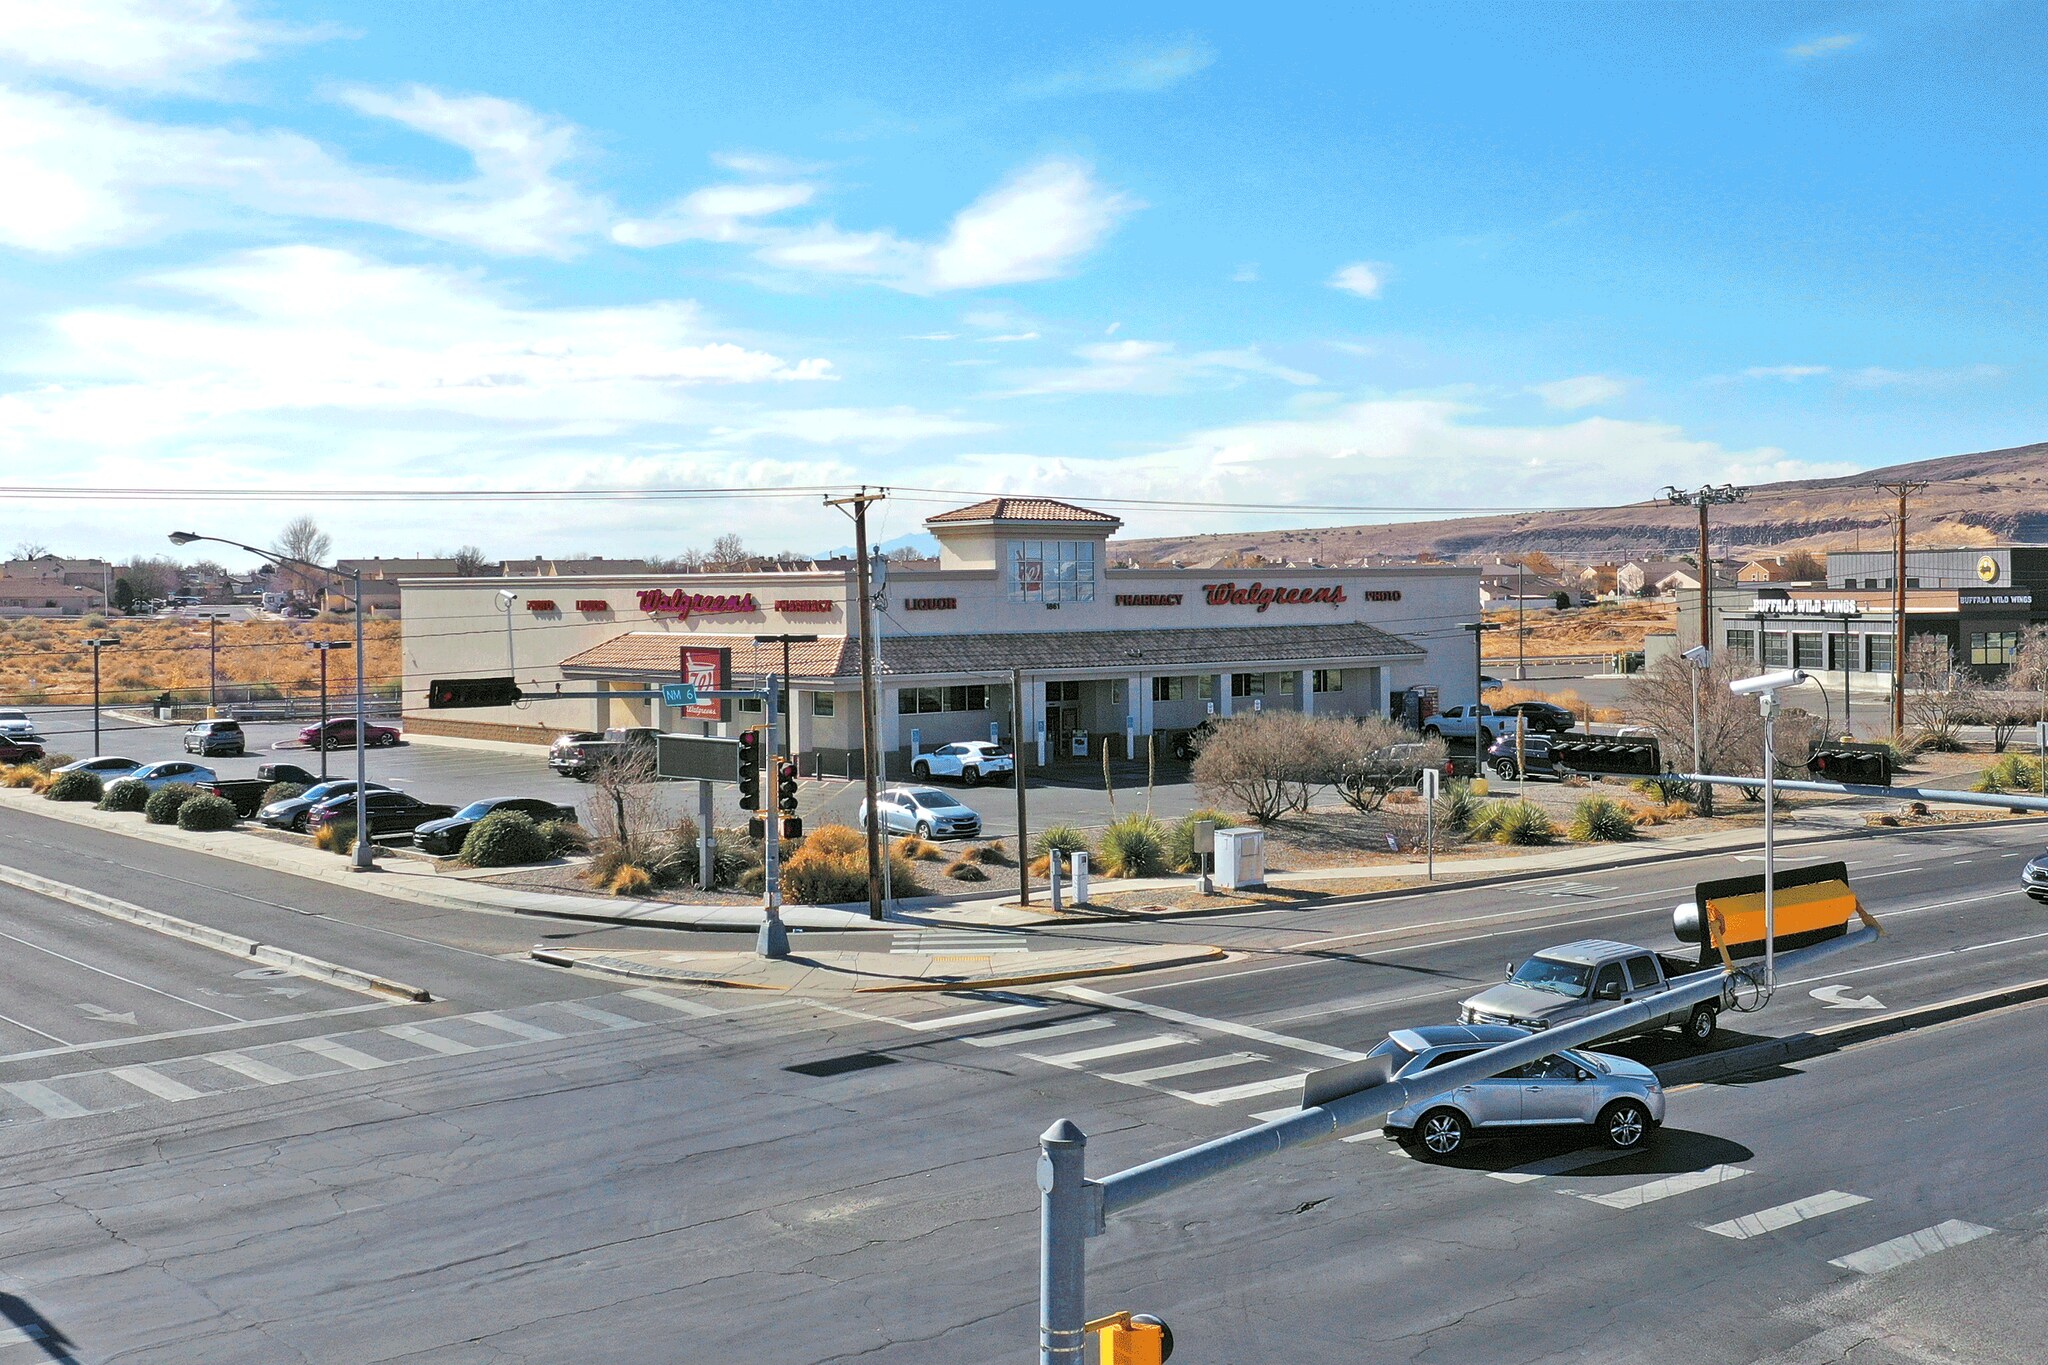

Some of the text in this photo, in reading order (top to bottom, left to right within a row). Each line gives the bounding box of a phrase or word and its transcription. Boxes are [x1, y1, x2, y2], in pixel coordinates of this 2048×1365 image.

[1114, 594, 1184, 606] PHARMACY
[1202, 582, 1348, 612] Walgreens
[1364, 590, 1402, 602] PHOTO
[1960, 595, 2033, 604] BUFFALO WILD WINGS
[636, 588, 757, 621] Walgreens
[774, 600, 833, 612] PHARMACY
[904, 598, 958, 611] LIQUOR
[1753, 599, 1857, 614] BUFFALO WILD WINGS
[666, 689, 694, 701] NM 6
[686, 706, 717, 716] Walgreens
